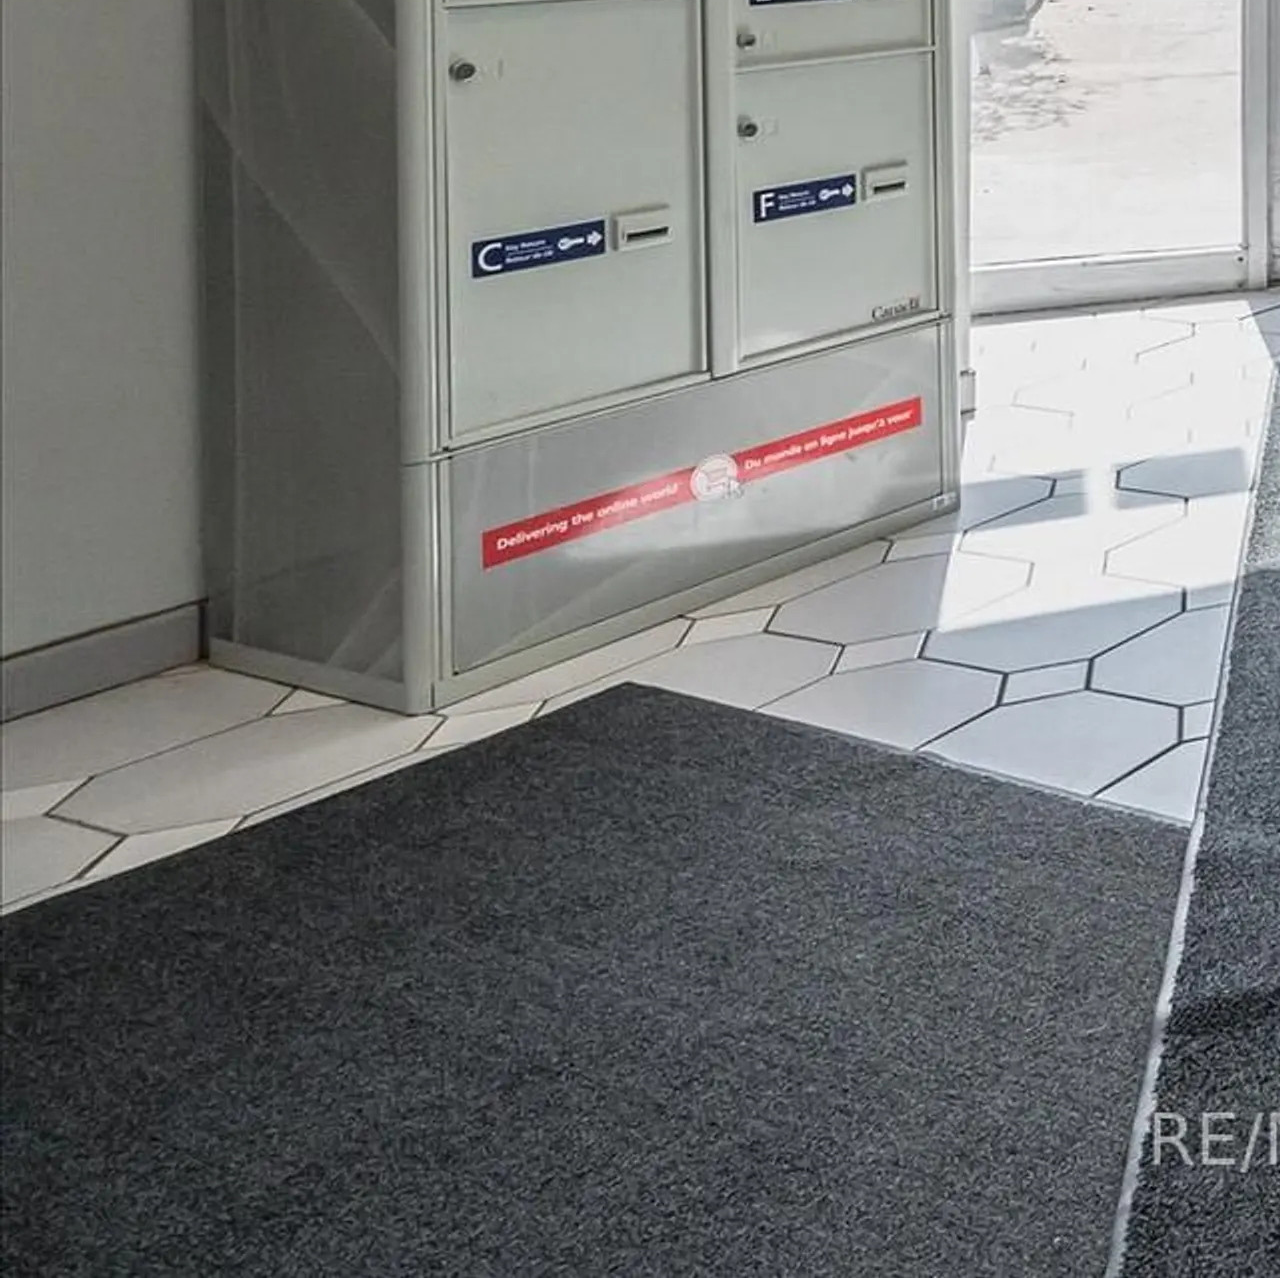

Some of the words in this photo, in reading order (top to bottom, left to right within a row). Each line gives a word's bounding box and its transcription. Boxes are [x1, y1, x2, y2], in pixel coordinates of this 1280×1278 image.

[761, 192, 774, 218] F
[478, 242, 503, 271] C
[744, 458, 762, 471] Du
[496, 519, 569, 551] Delivering
[571, 512, 595, 526] the
[597, 497, 638, 518] online
[640, 482, 679, 505] world
